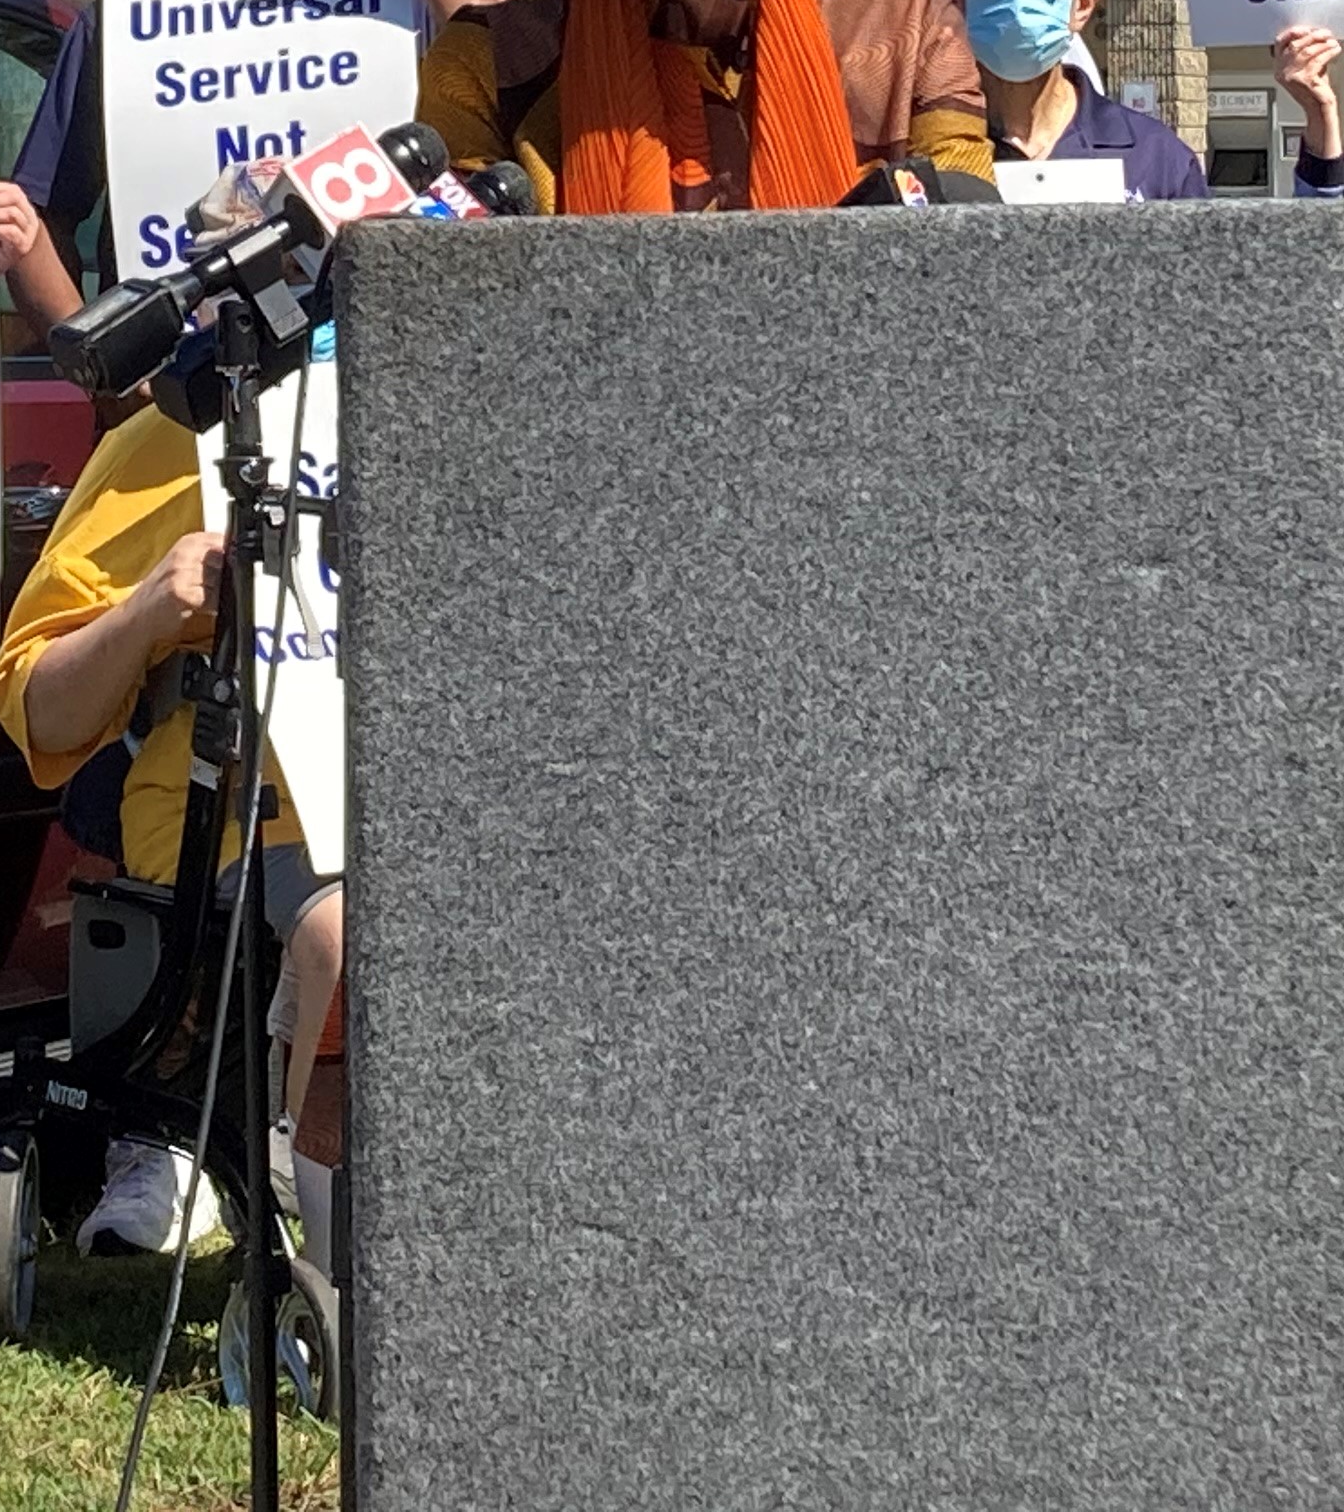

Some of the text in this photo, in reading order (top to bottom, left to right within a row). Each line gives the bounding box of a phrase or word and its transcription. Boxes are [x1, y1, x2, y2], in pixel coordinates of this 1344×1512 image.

[155, 48, 360, 109] Service
[215, 119, 307, 174] Not
[310, 147, 392, 221] 8
